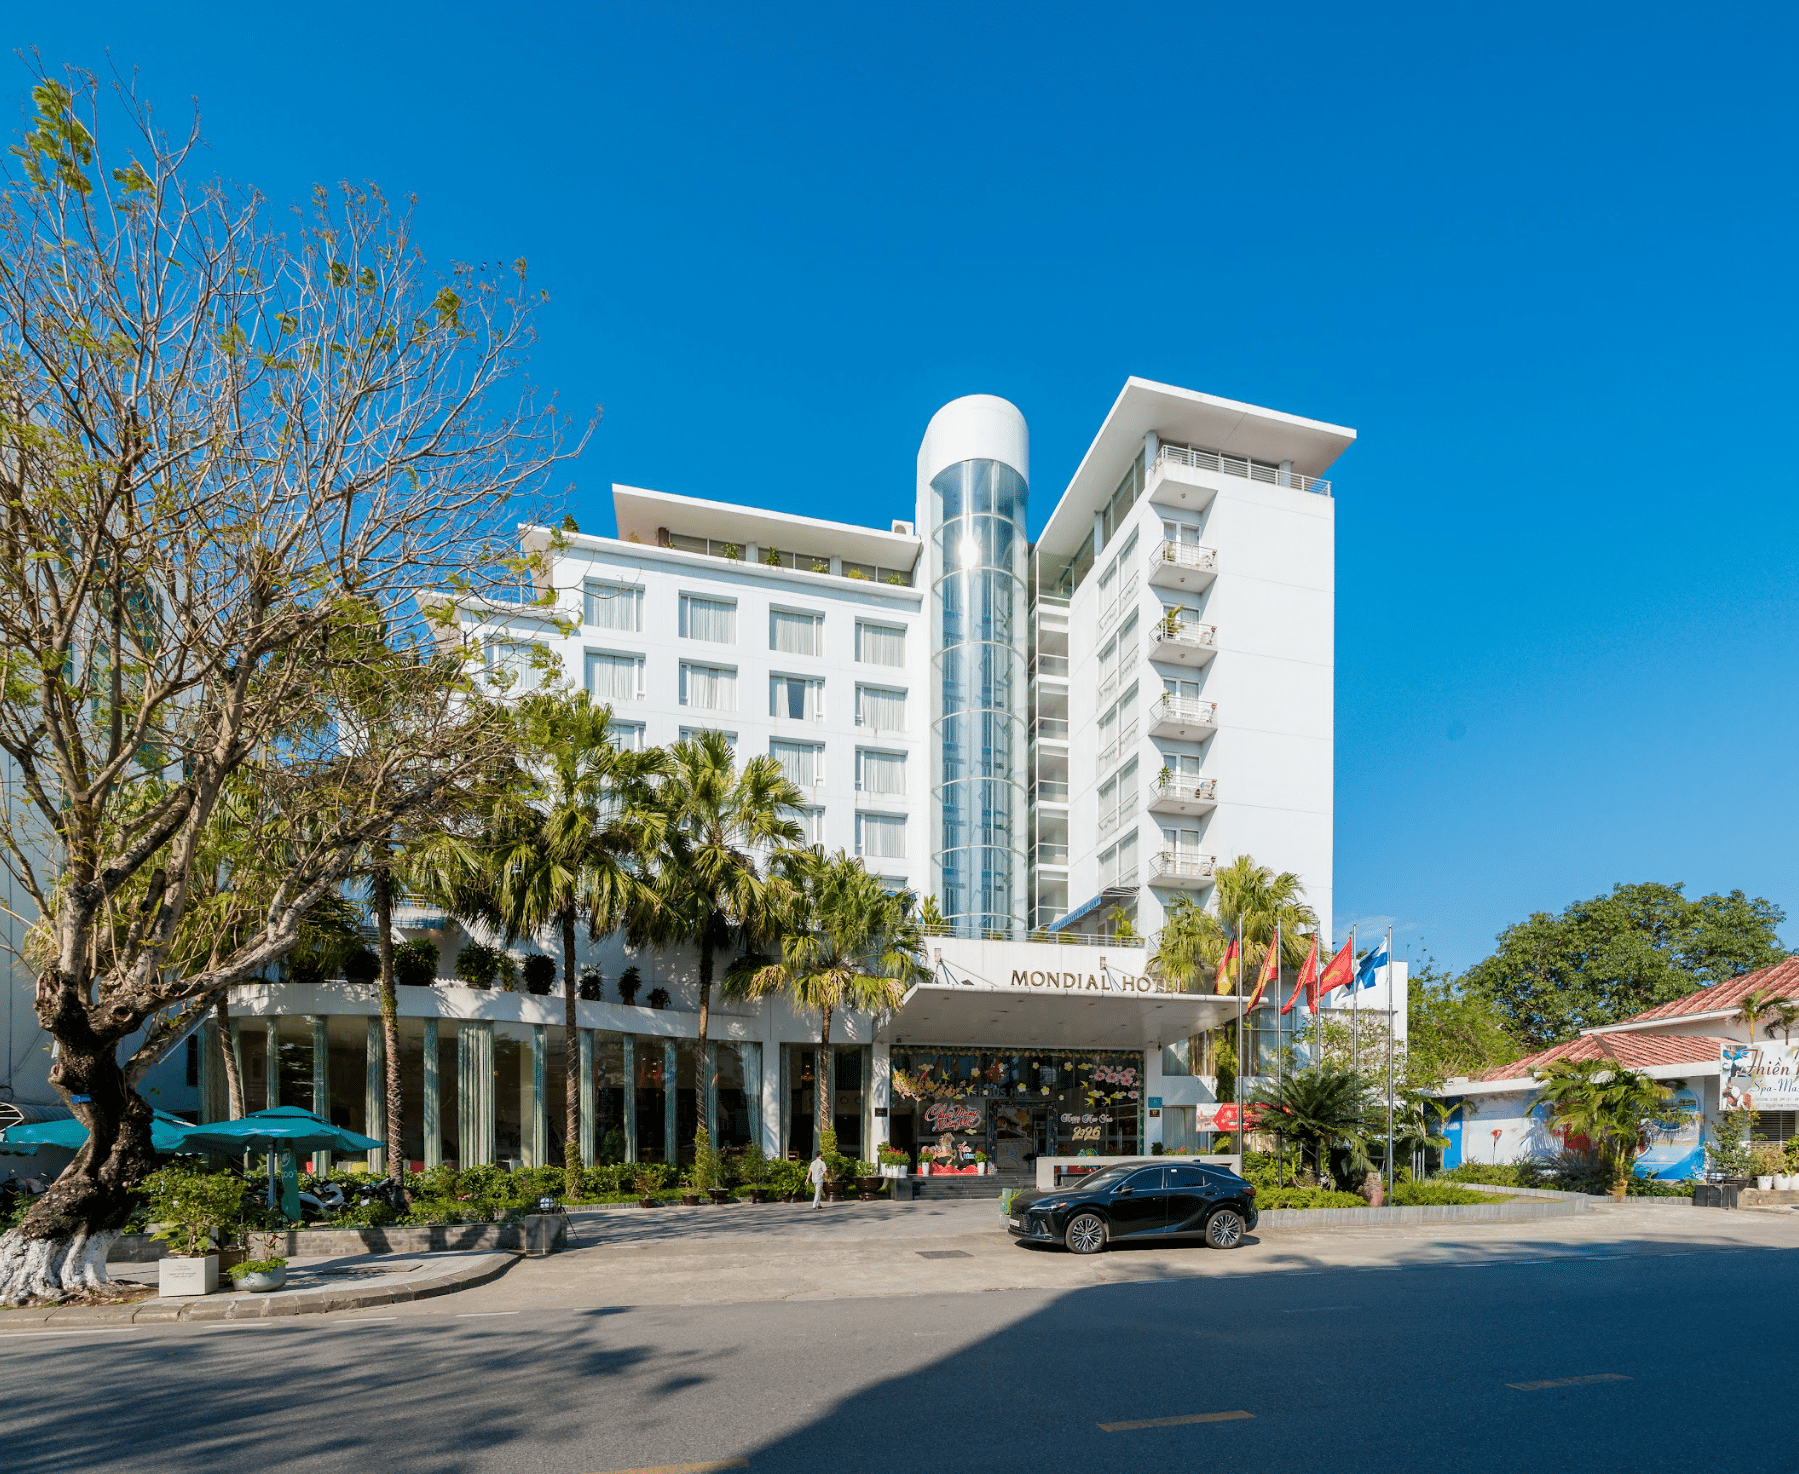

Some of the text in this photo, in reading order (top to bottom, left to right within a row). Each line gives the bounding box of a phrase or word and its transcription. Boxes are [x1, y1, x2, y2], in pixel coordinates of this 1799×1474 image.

[1011, 969, 1111, 991] MONDIAL
[1740, 1048, 1790, 1075] Thiền
[1071, 1126, 1102, 1141] 2026
